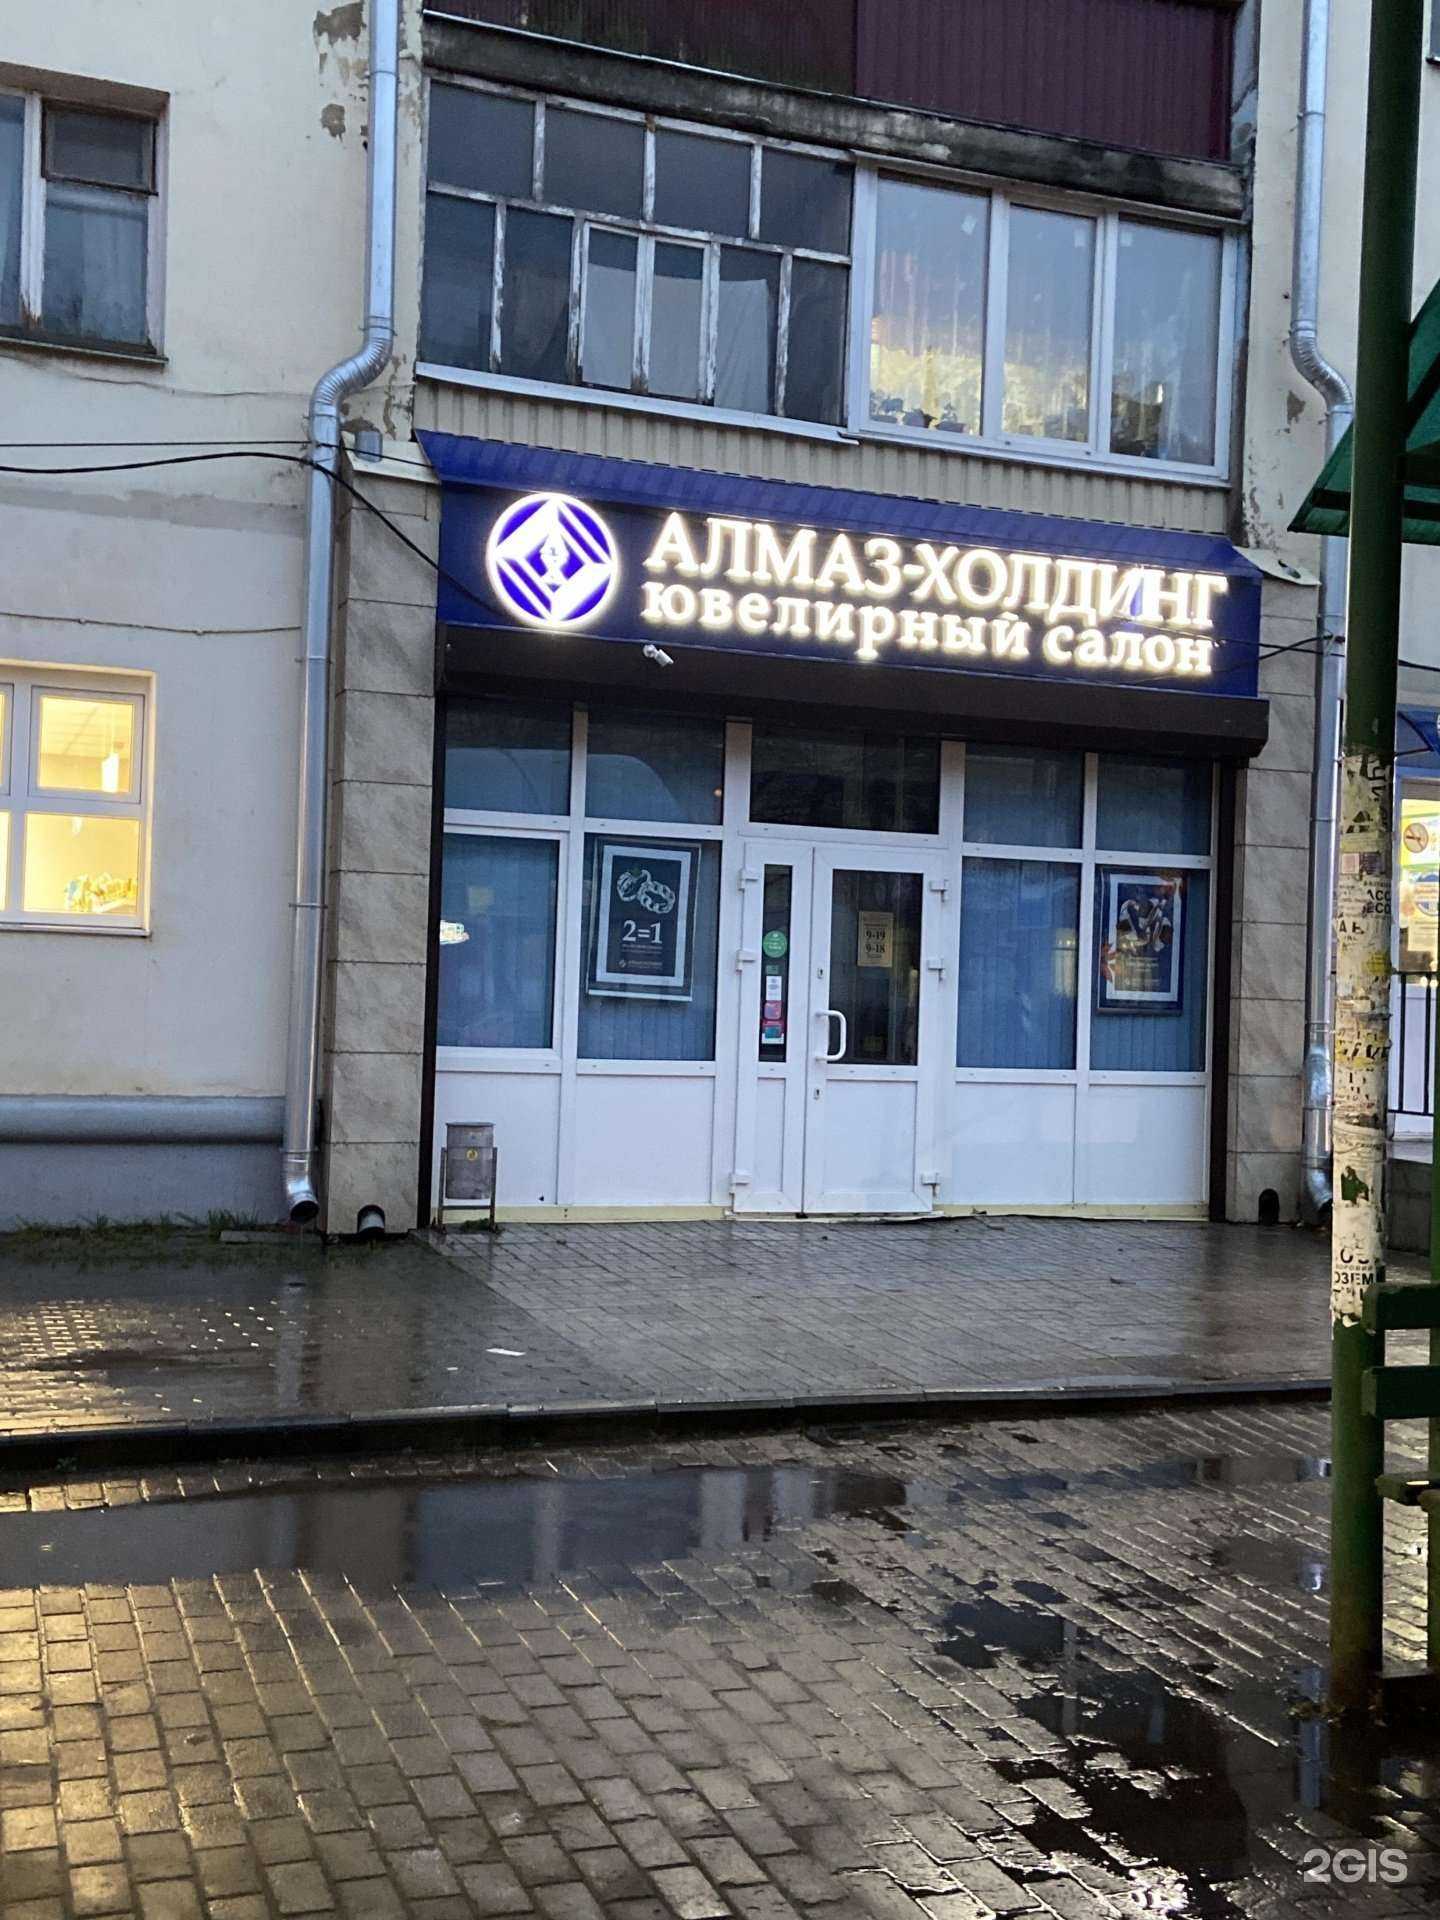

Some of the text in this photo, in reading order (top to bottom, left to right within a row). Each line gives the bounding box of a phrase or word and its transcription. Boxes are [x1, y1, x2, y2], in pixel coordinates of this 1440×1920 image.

[643, 511, 1228, 629] АЛМАЗ-ХОЛДИНГ
[641, 581, 1212, 676] ювелирный салон
[622, 920, 662, 944] 2=1
